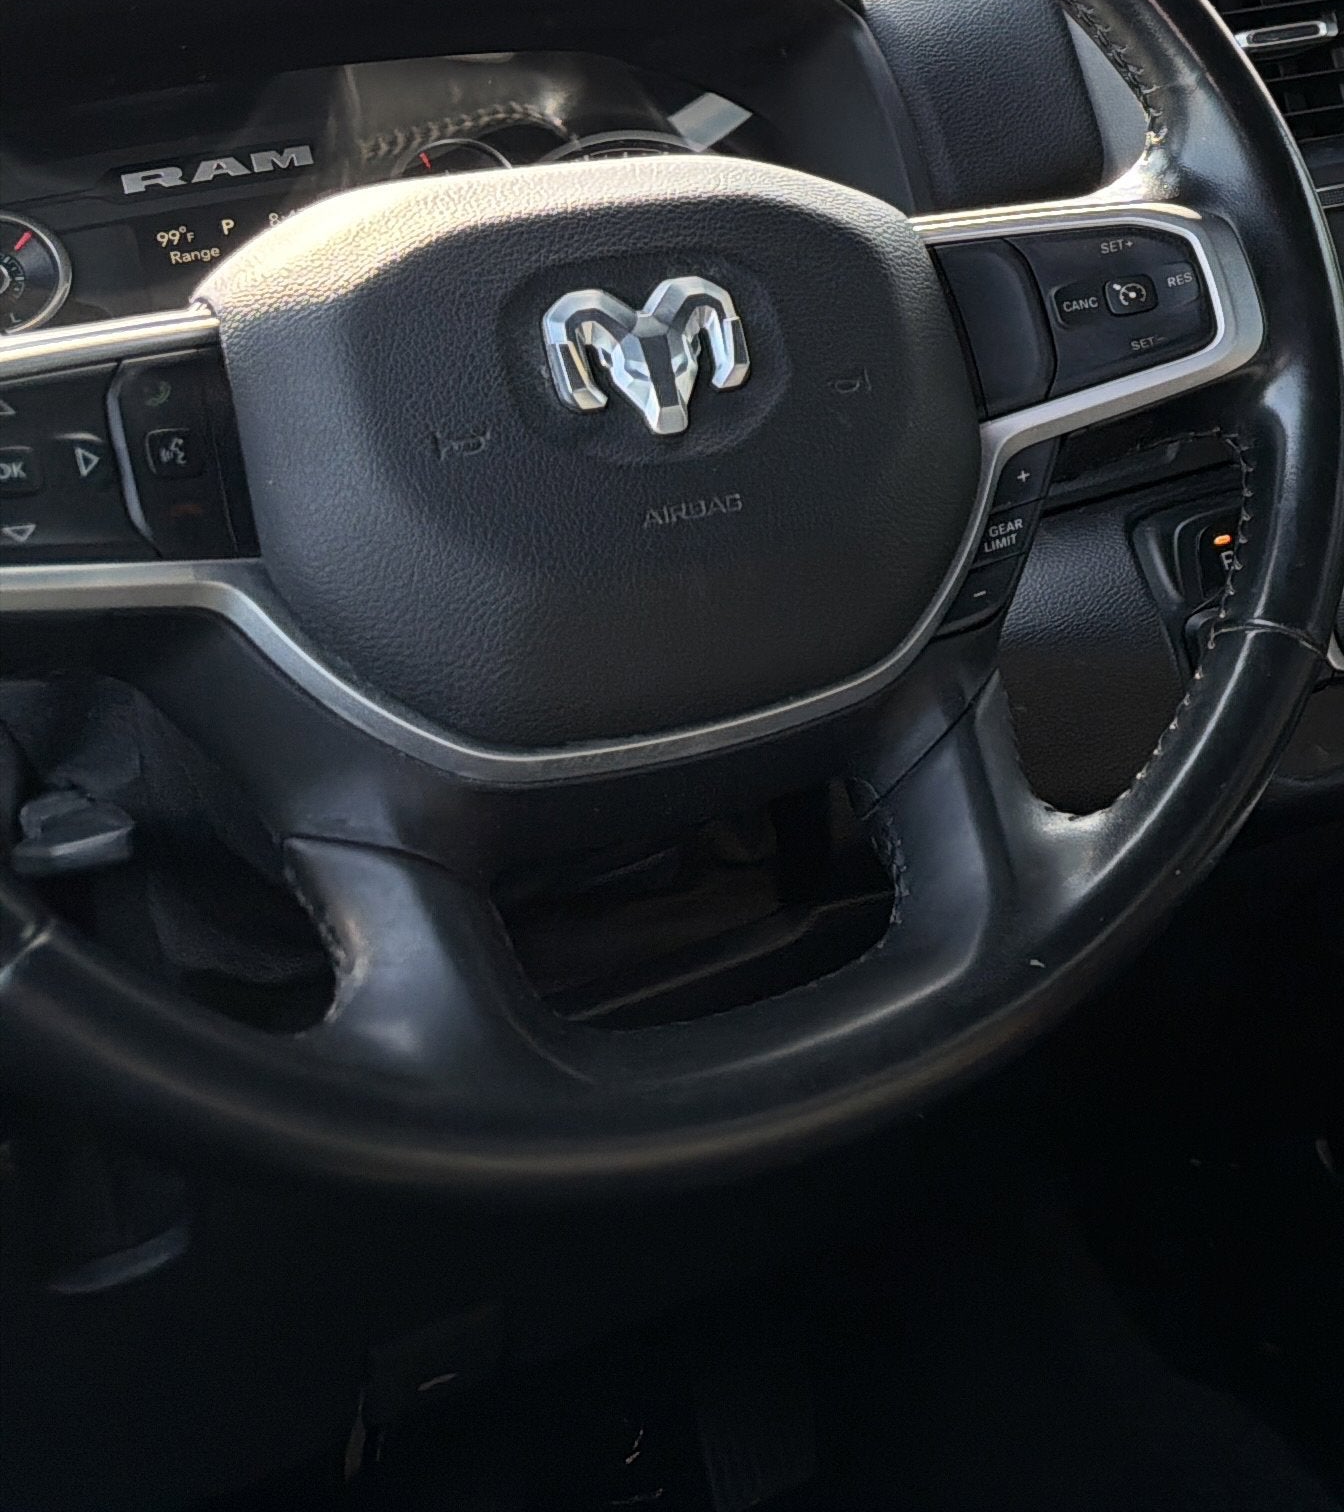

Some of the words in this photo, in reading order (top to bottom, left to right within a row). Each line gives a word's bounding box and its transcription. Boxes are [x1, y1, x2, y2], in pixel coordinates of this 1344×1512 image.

[121, 145, 314, 195] RAM
[156, 225, 195, 248] 99°F
[221, 219, 235, 236] P
[169, 246, 221, 265] Range
[1166, 272, 1193, 288] RES
[1062, 294, 1098, 313] CANC
[0, 461, 27, 480] OK
[988, 518, 1024, 538] GEAR
[983, 533, 1018, 553] LIMIT
